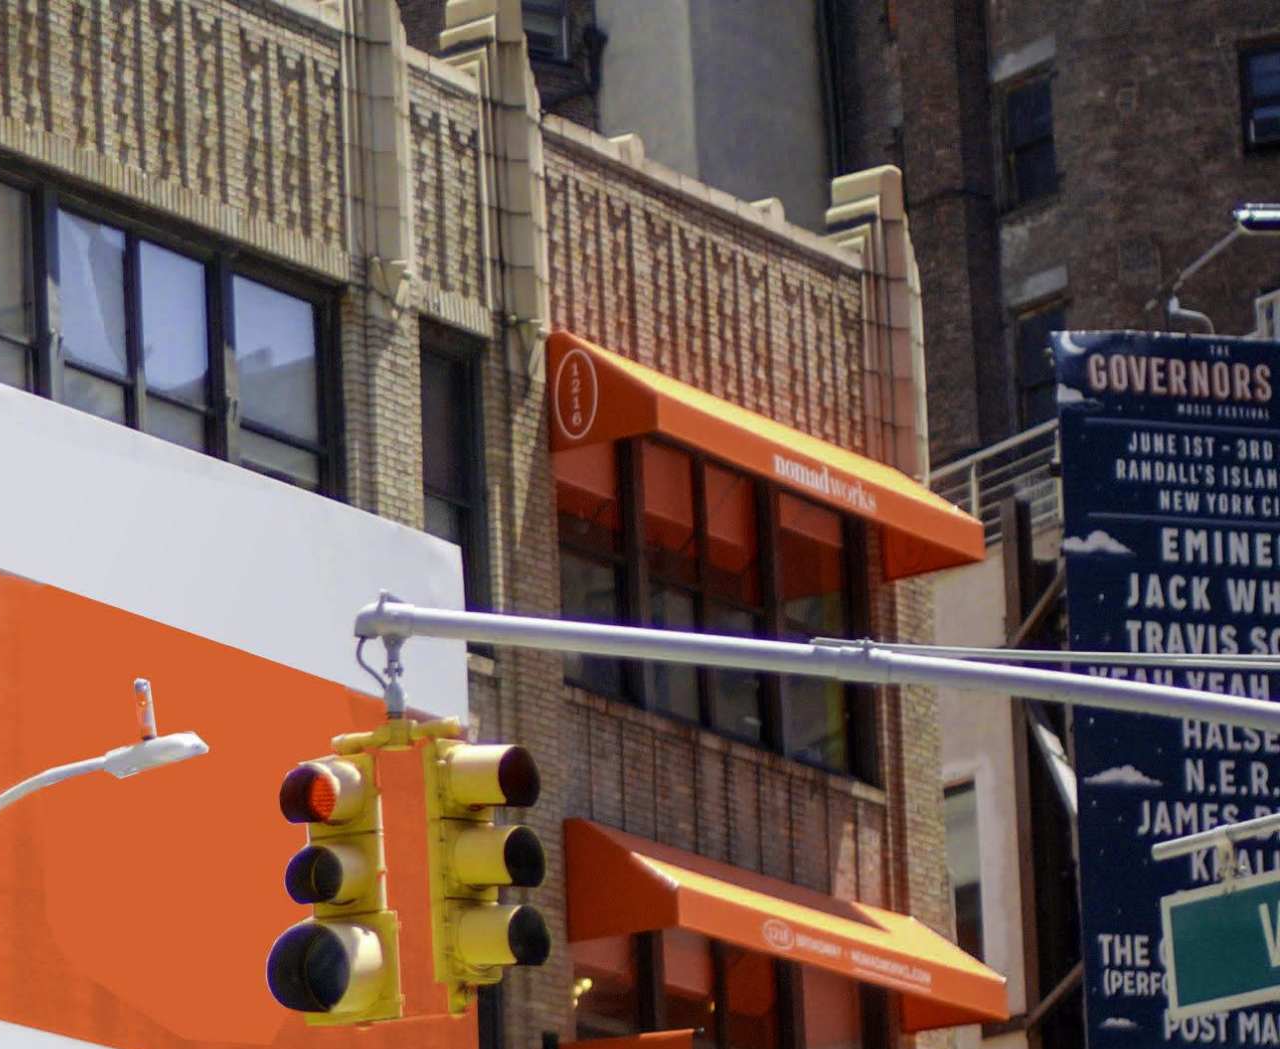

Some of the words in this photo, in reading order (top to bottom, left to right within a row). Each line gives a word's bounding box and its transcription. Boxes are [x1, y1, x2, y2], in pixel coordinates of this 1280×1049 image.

[569, 361, 583, 427] 1216
[1088, 353, 1273, 401] GOVERNORS
[1128, 431, 1177, 456] JUNE
[1184, 435, 1216, 459] 1ST
[1237, 438, 1274, 461] 3RD
[772, 453, 878, 514] nomadworks
[1115, 458, 1216, 487] RANDALL'S
[1159, 490, 1200, 513] NEW
[1205, 493, 1256, 516] YORK
[1161, 527, 1280, 568] EMINE
[1126, 572, 1212, 612] JACK
[1125, 619, 1239, 655] TRAVIS
[1137, 800, 1239, 836] JAMES
[1098, 933, 1151, 966] THE
[1164, 1009, 1229, 1042] POST
[1238, 1011, 1280, 1045] MA
